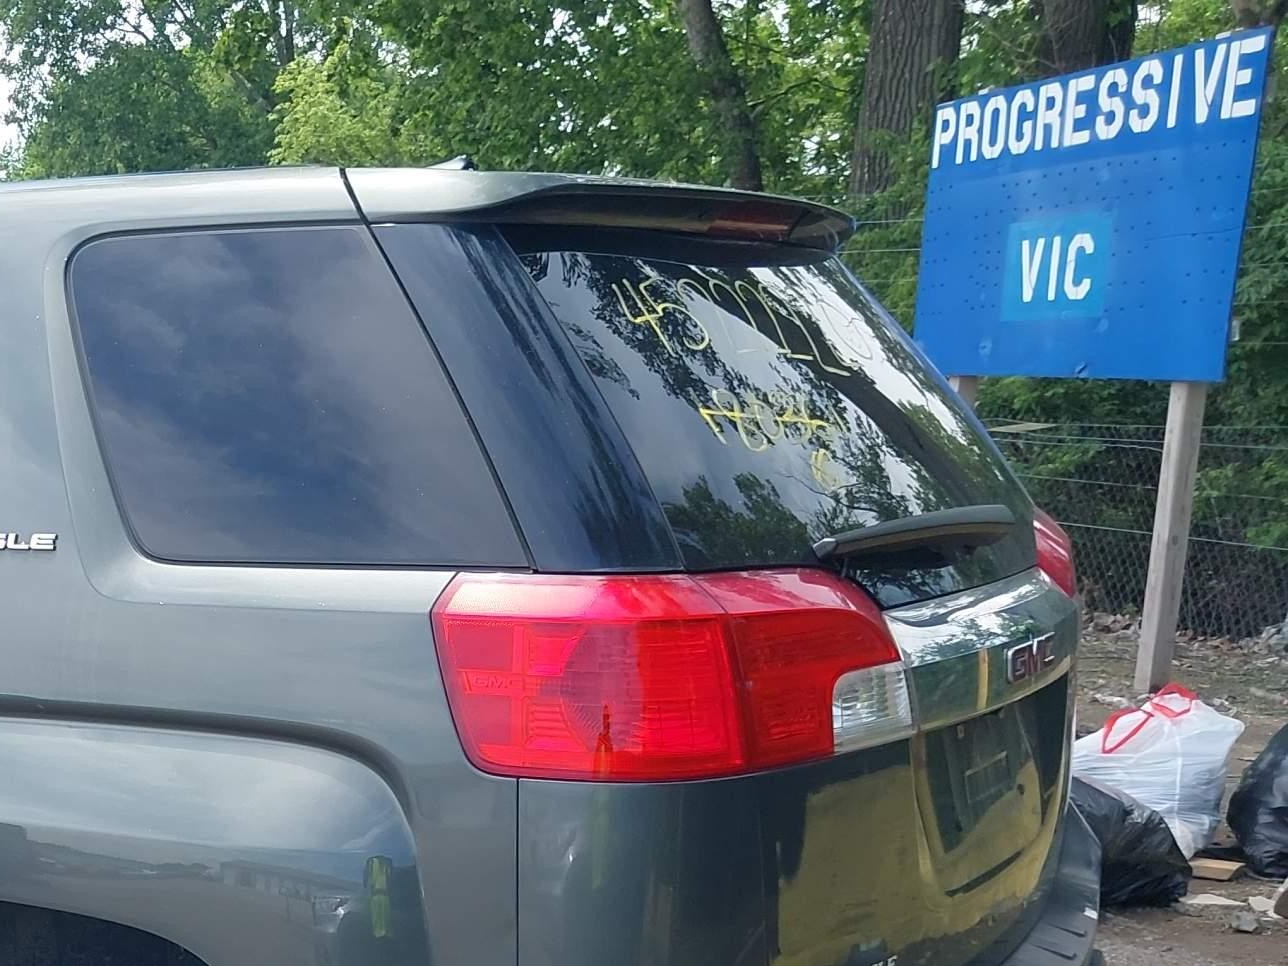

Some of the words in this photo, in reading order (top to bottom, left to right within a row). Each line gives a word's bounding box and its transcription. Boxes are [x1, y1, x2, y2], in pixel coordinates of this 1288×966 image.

[931, 34, 1267, 169] PROGRESSIVE
[1021, 232, 1095, 303] VIC
[1007, 631, 1056, 684] GMC
